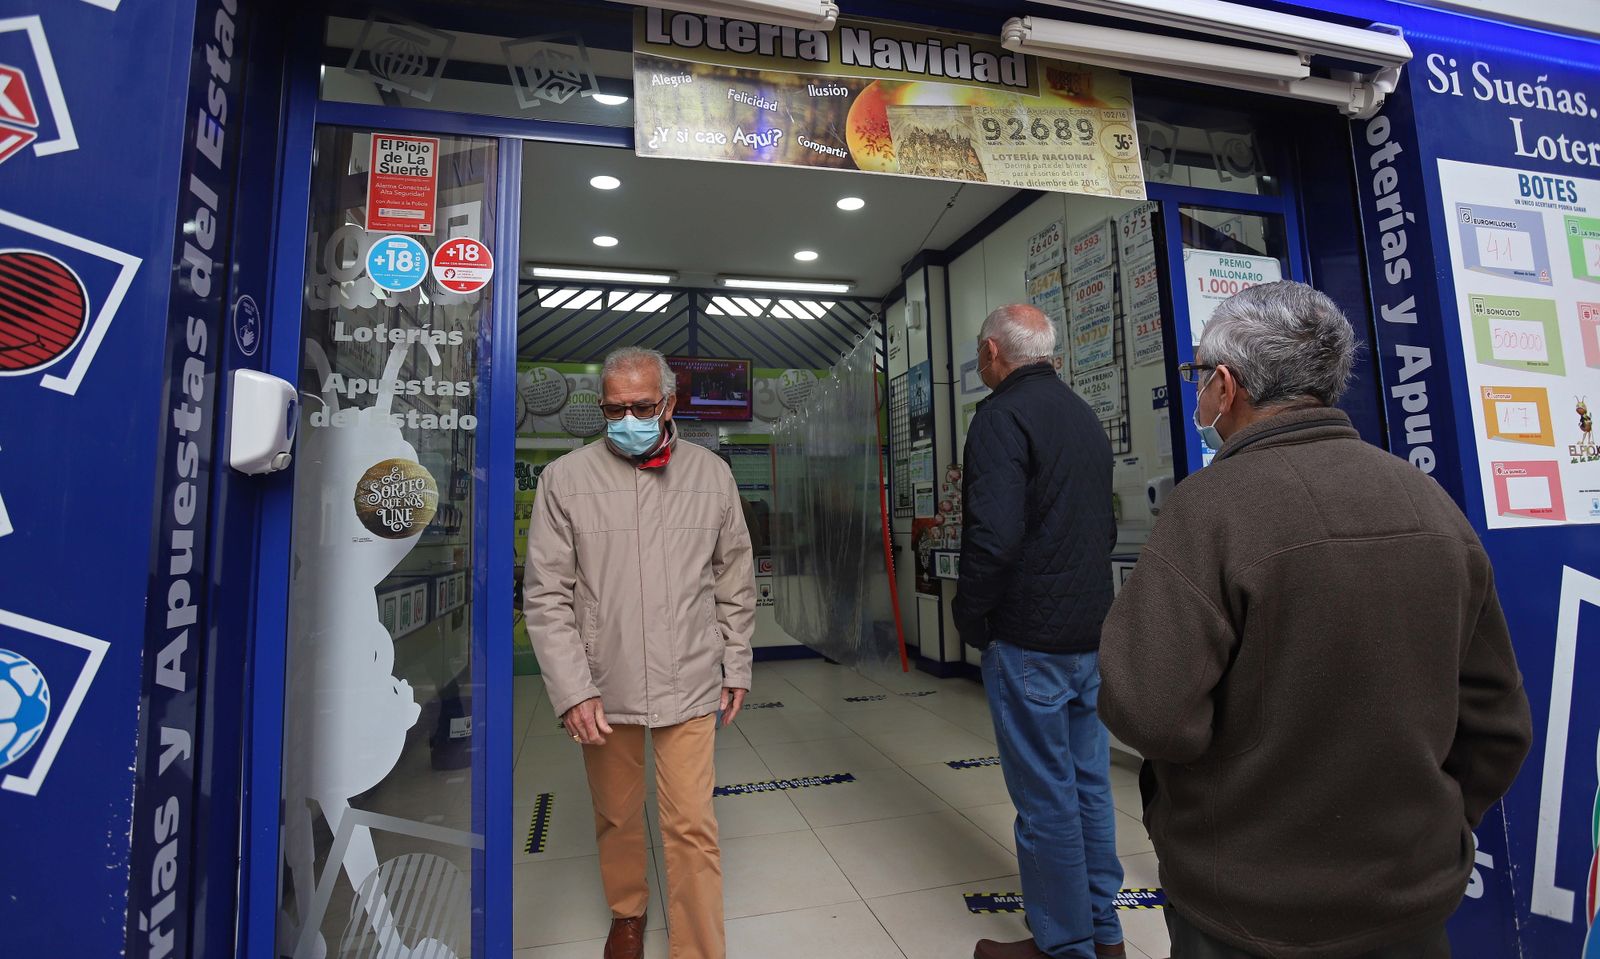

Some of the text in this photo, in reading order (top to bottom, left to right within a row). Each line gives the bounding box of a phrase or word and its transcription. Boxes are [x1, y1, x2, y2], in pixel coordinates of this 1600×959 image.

[839, 26, 1029, 88] Navidad
[196, 0, 238, 170] Esta
[651, 71, 692, 88] Alegría
[1426, 53, 1464, 96] Si
[727, 88, 778, 112] Felicidad
[808, 83, 849, 98] Ilusión
[1102, 110, 1126, 119] 102/16
[649, 126, 783, 150] ¿Y si cae Aquí?
[981, 117, 1094, 141] 92689
[380, 139, 430, 155] El Piojo
[797, 135, 848, 160] Compartir
[992, 152, 1096, 161] LOTERÍA NACIONAL
[379, 162, 429, 177] Suerte
[383, 151, 425, 166] de La
[1013, 179, 1024, 187] de
[1026, 179, 1067, 187] diciembre
[1081, 179, 1100, 187] 2016
[1518, 173, 1578, 204] BOTES
[1133, 202, 1159, 219] PREMI
[1473, 218, 1517, 229] EUROMILLONES
[183, 173, 218, 298] del
[1030, 231, 1060, 257] 56406
[374, 249, 421, 272] +18 AÑOS
[446, 243, 480, 261] +18
[1219, 257, 1252, 269] PREMIO
[1209, 268, 1263, 281] MILLONARIO
[1380, 294, 1418, 324] y
[1486, 308, 1521, 317] BONOLOTO
[334, 321, 463, 345] Loterías
[321, 373, 471, 399] Apuestas
[530, 367, 548, 383] 15
[1092, 370, 1114, 381] PREMIO
[370, 408, 478, 430] Estado
[368, 478, 425, 506] SORTEO
[382, 492, 425, 510] QUE NOS
[155, 316, 208, 692] Apuestas
[376, 508, 414, 532] UNE
[159, 726, 192, 776] y
